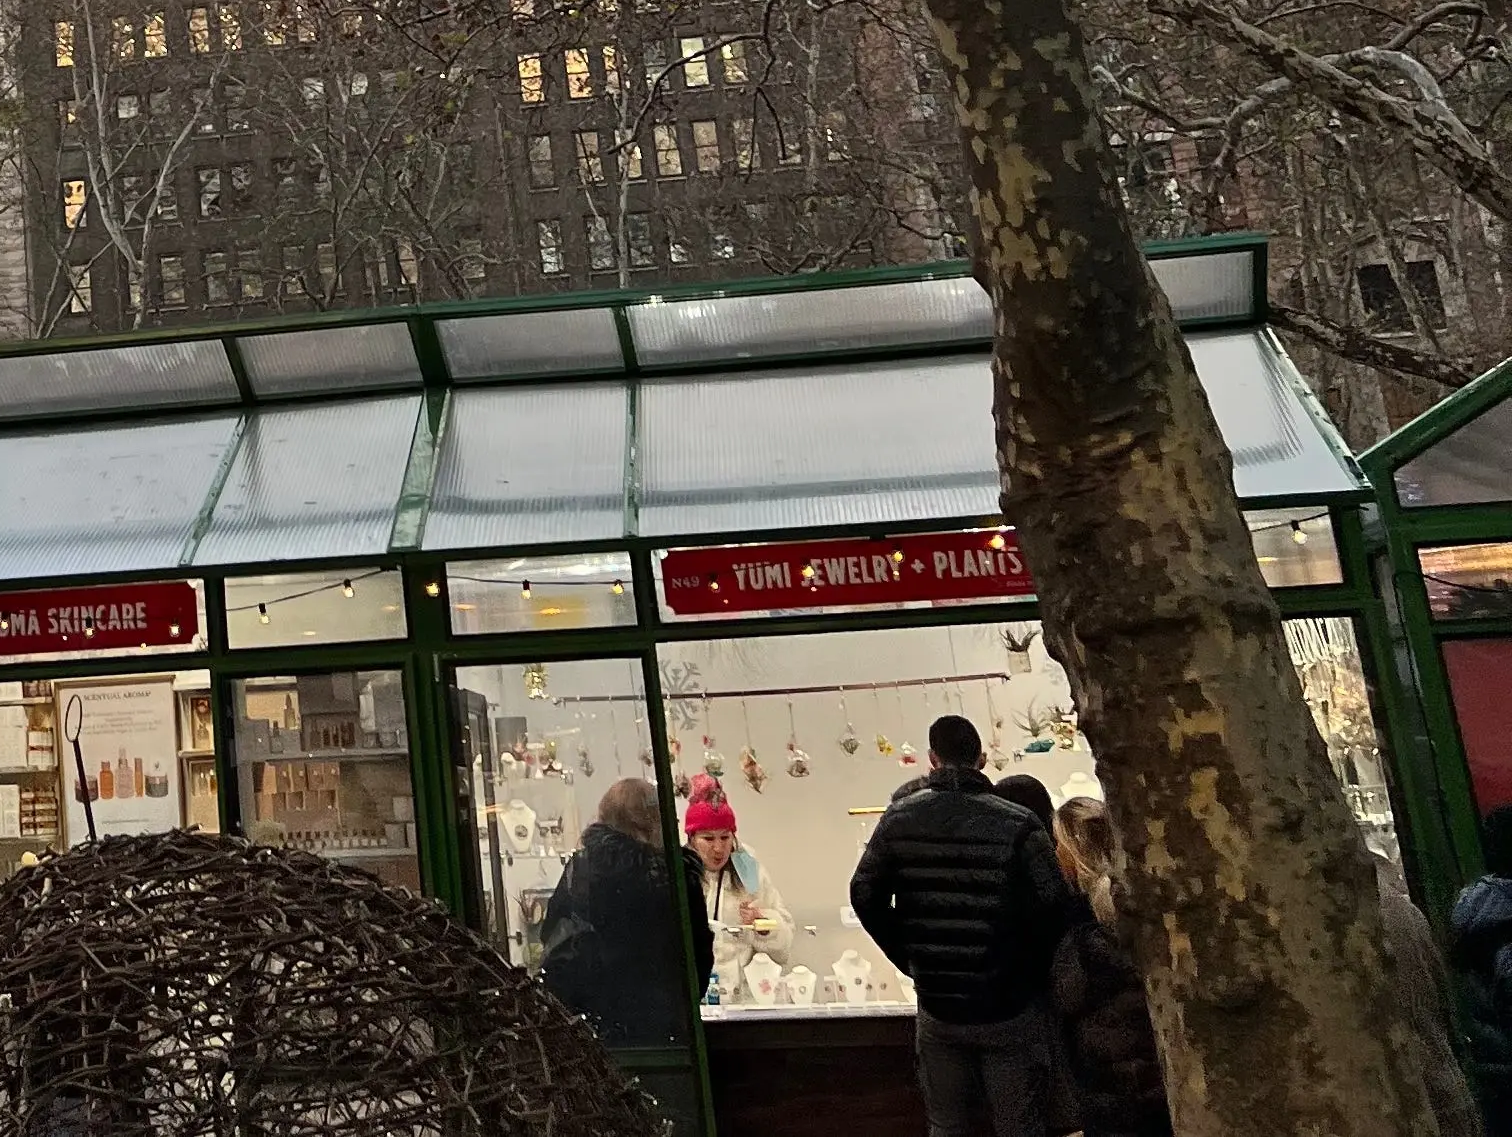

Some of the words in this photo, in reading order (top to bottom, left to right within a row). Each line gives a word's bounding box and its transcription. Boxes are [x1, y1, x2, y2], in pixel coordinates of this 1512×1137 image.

[910, 558, 926, 574] +
[932, 547, 1024, 579] PLANTS
[671, 576, 700, 589] N49
[48, 601, 148, 634] SKINCARE
